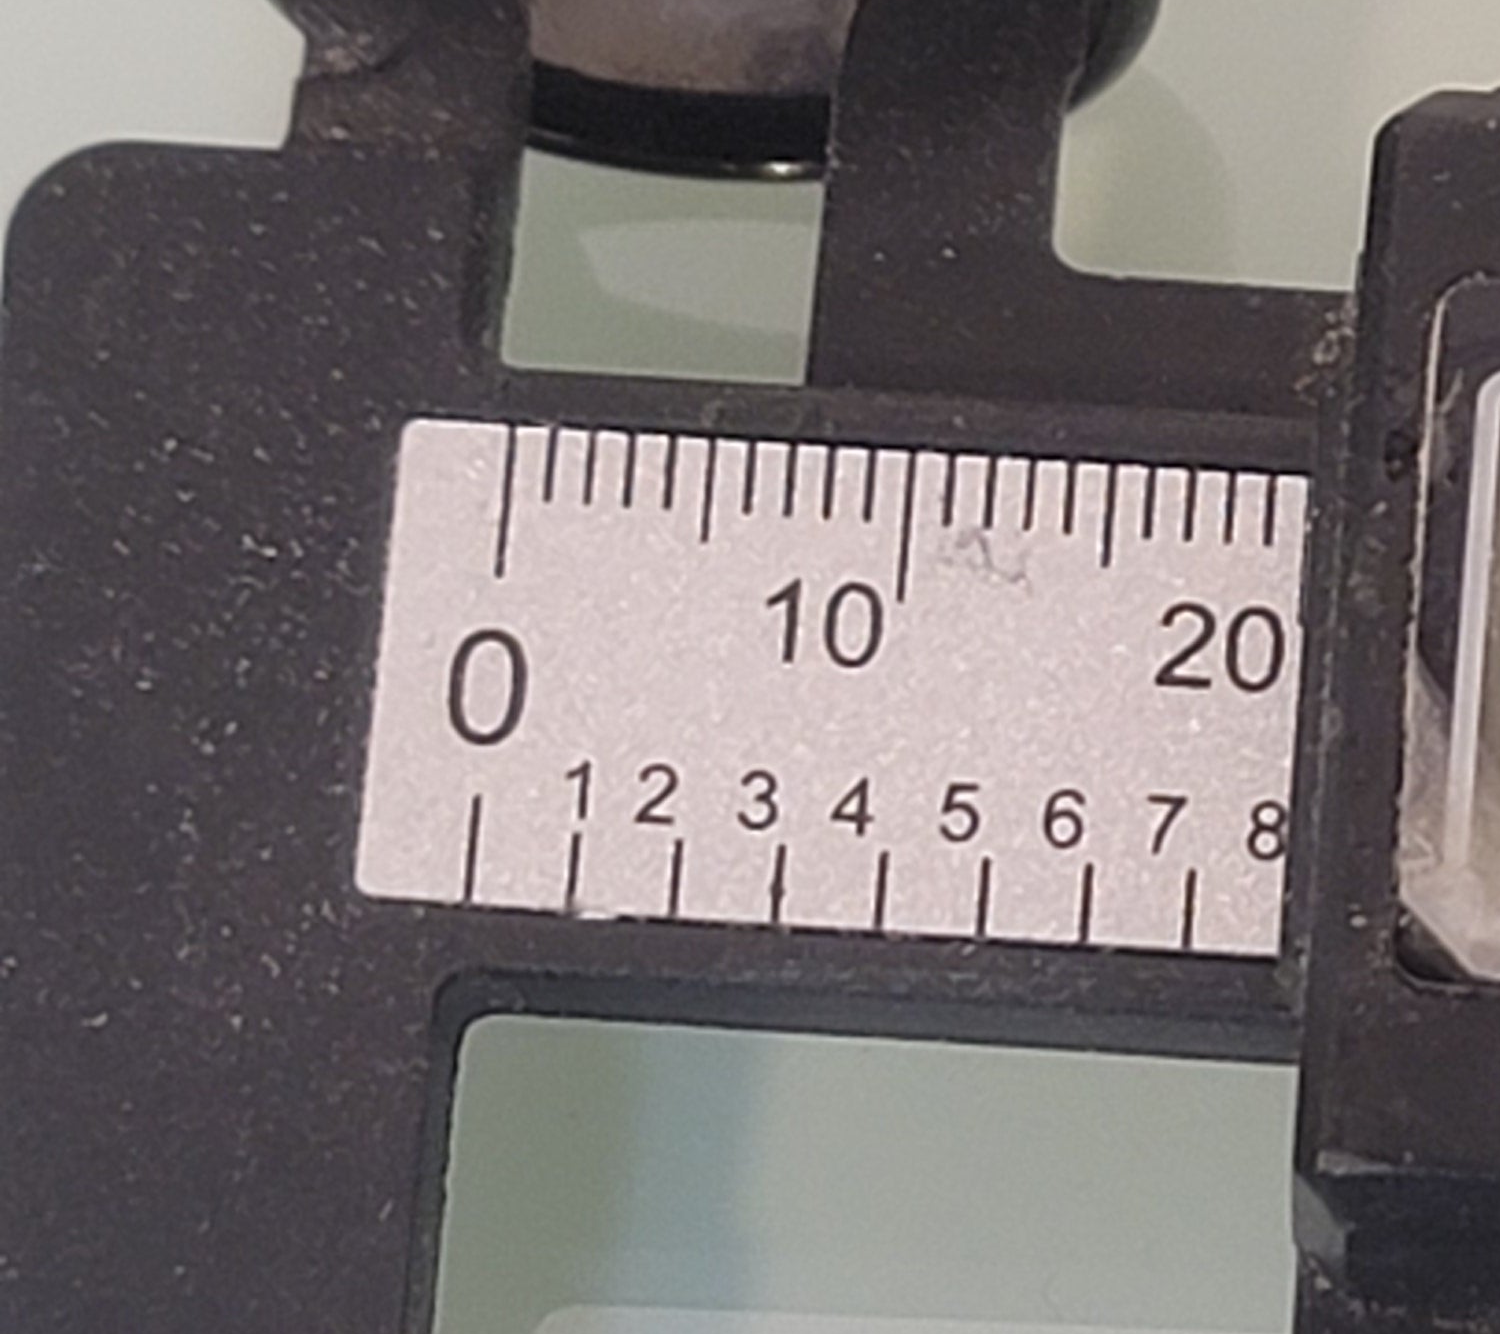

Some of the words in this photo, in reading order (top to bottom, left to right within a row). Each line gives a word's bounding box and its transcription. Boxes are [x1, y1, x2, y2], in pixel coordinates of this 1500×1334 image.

[447, 629, 528, 746] 0
[766, 578, 884, 668] 10
[1154, 603, 1286, 693] 20
[564, 761, 594, 821] 1
[634, 763, 679, 827] 2
[737, 770, 780, 831] 3
[830, 777, 875, 837] 4
[938, 783, 982, 843] 5
[1041, 789, 1088, 849] 6
[1145, 795, 1188, 855] 7
[1245, 801, 1289, 862] 8
